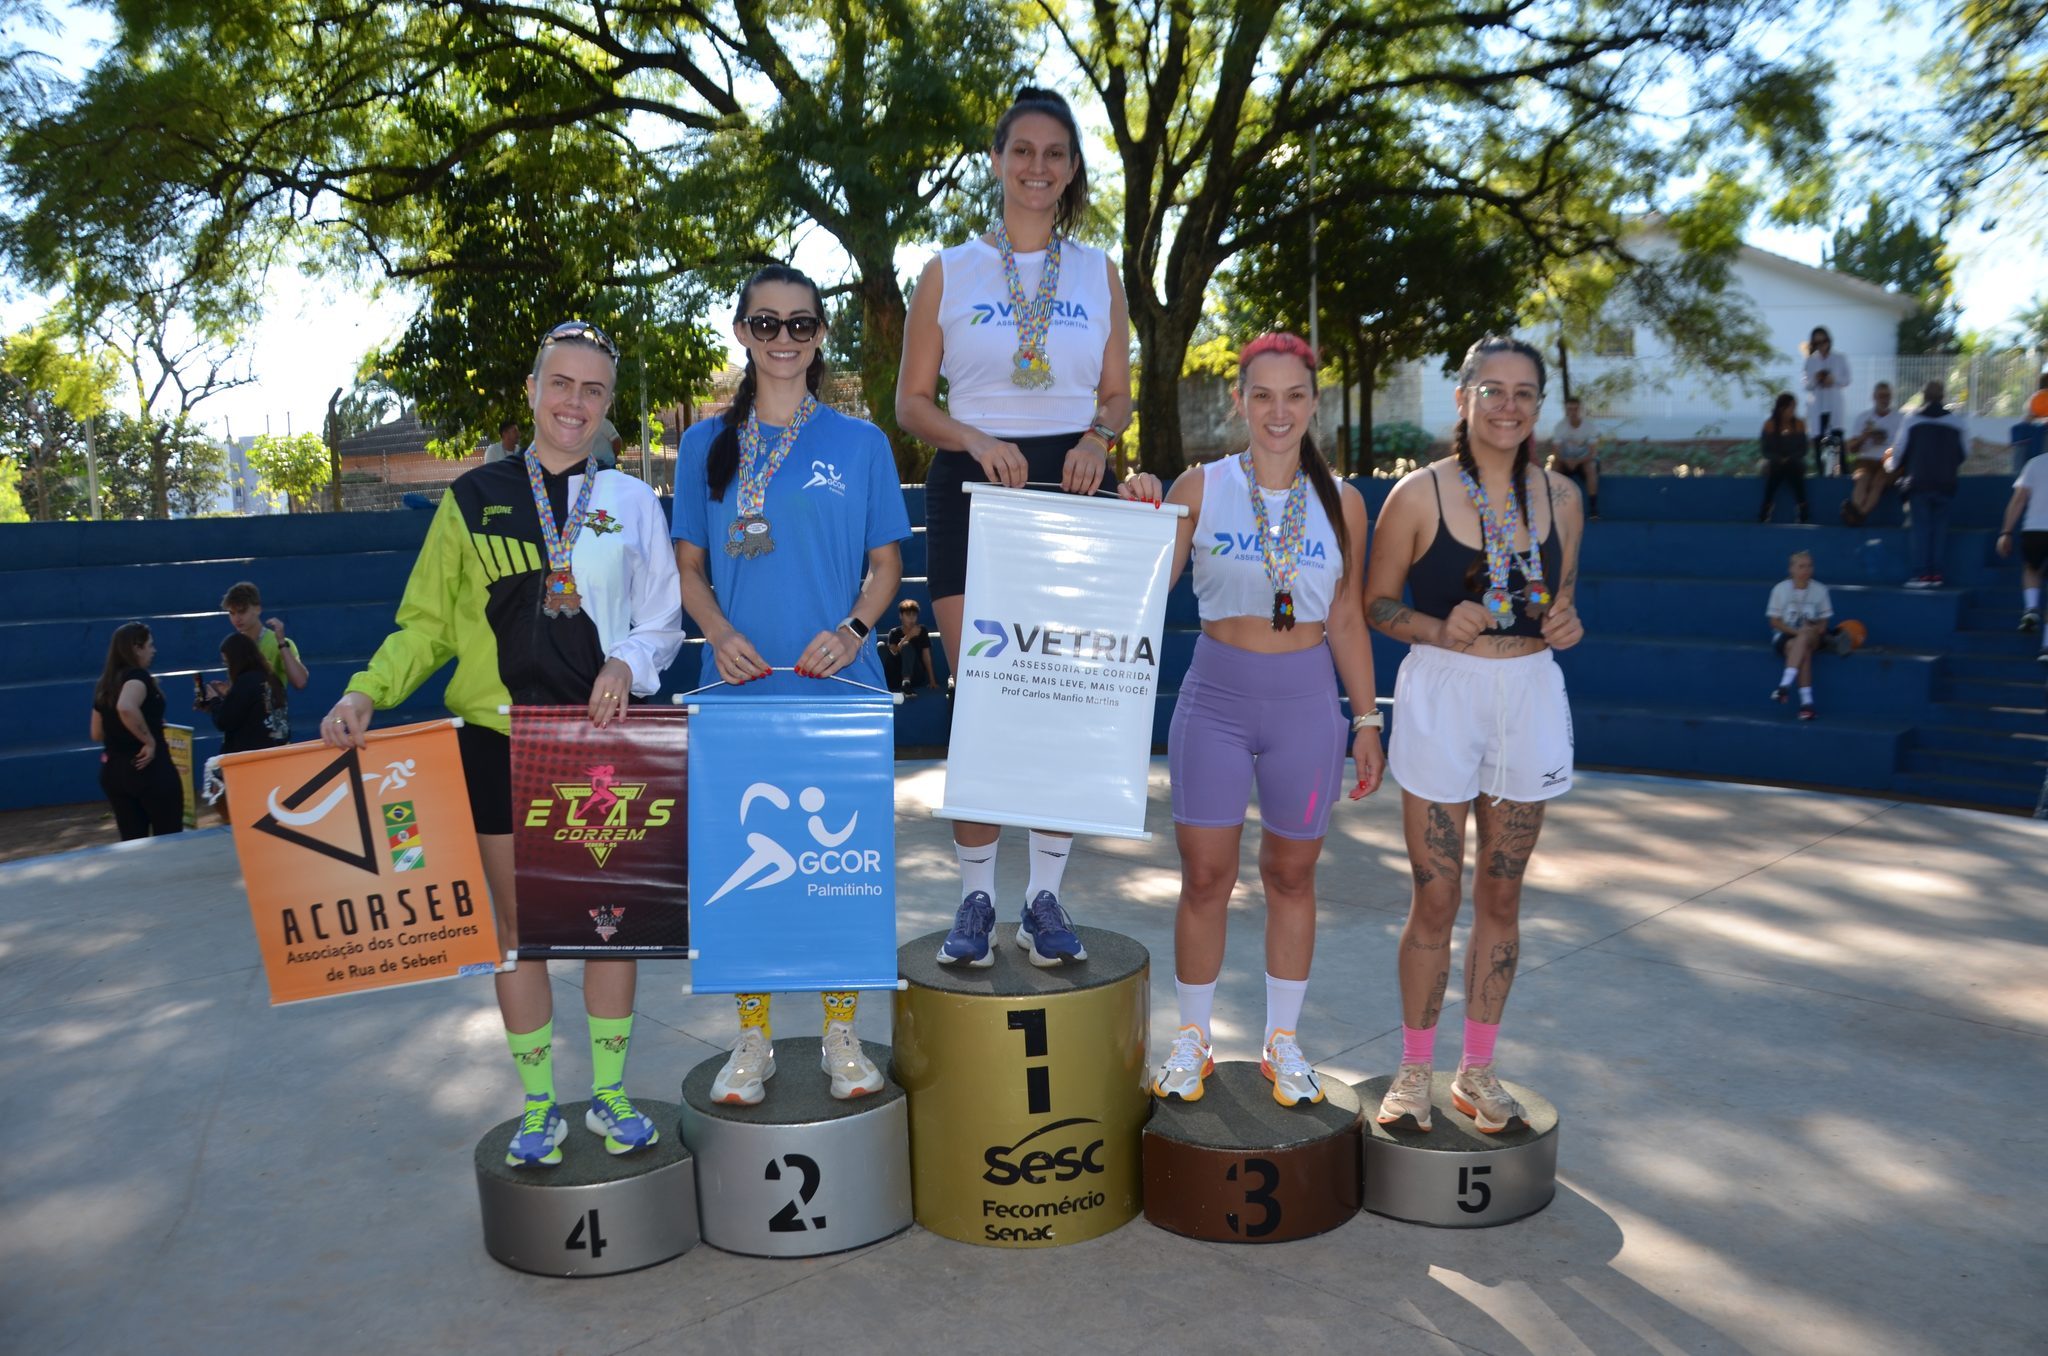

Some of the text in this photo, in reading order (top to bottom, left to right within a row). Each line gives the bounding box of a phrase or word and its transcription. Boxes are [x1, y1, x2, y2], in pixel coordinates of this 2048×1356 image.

[996, 300, 1089, 321] VRIA
[1013, 623, 1156, 666] VETRIA
[966, 669, 990, 679] MAIS
[993, 672, 1029, 684] LONGE,
[1032, 675, 1057, 686] MAIS
[1060, 679, 1087, 690] LEVE,
[1090, 682, 1115, 692] MAIS
[1011, 659, 1151, 682] ASSESSORIA DE CORRIDA
[1001, 686, 1120, 707] Prof Carlos Manfio Martins
[524, 799, 676, 827] ELAS
[553, 828, 648, 841] CORREM
[798, 850, 882, 875] GCOR
[807, 883, 883, 897] Palmitinho
[282, 880, 474, 946] ACORSEB
[286, 923, 479, 965] Associação dos Corredores
[326, 967, 345, 982] de
[348, 964, 376, 978] Rua
[379, 959, 398, 973] de
[402, 950, 448, 970] Seberi
[1007, 1008, 1051, 1115] 1
[982, 1138, 1105, 1186] Sesc
[765, 1153, 827, 1233] 2
[1226, 1158, 1282, 1238] 3
[1456, 1165, 1492, 1214] 5
[982, 1191, 1106, 1219] Fecomércio
[565, 1208, 608, 1259] 4
[984, 1223, 1054, 1242] Senac
